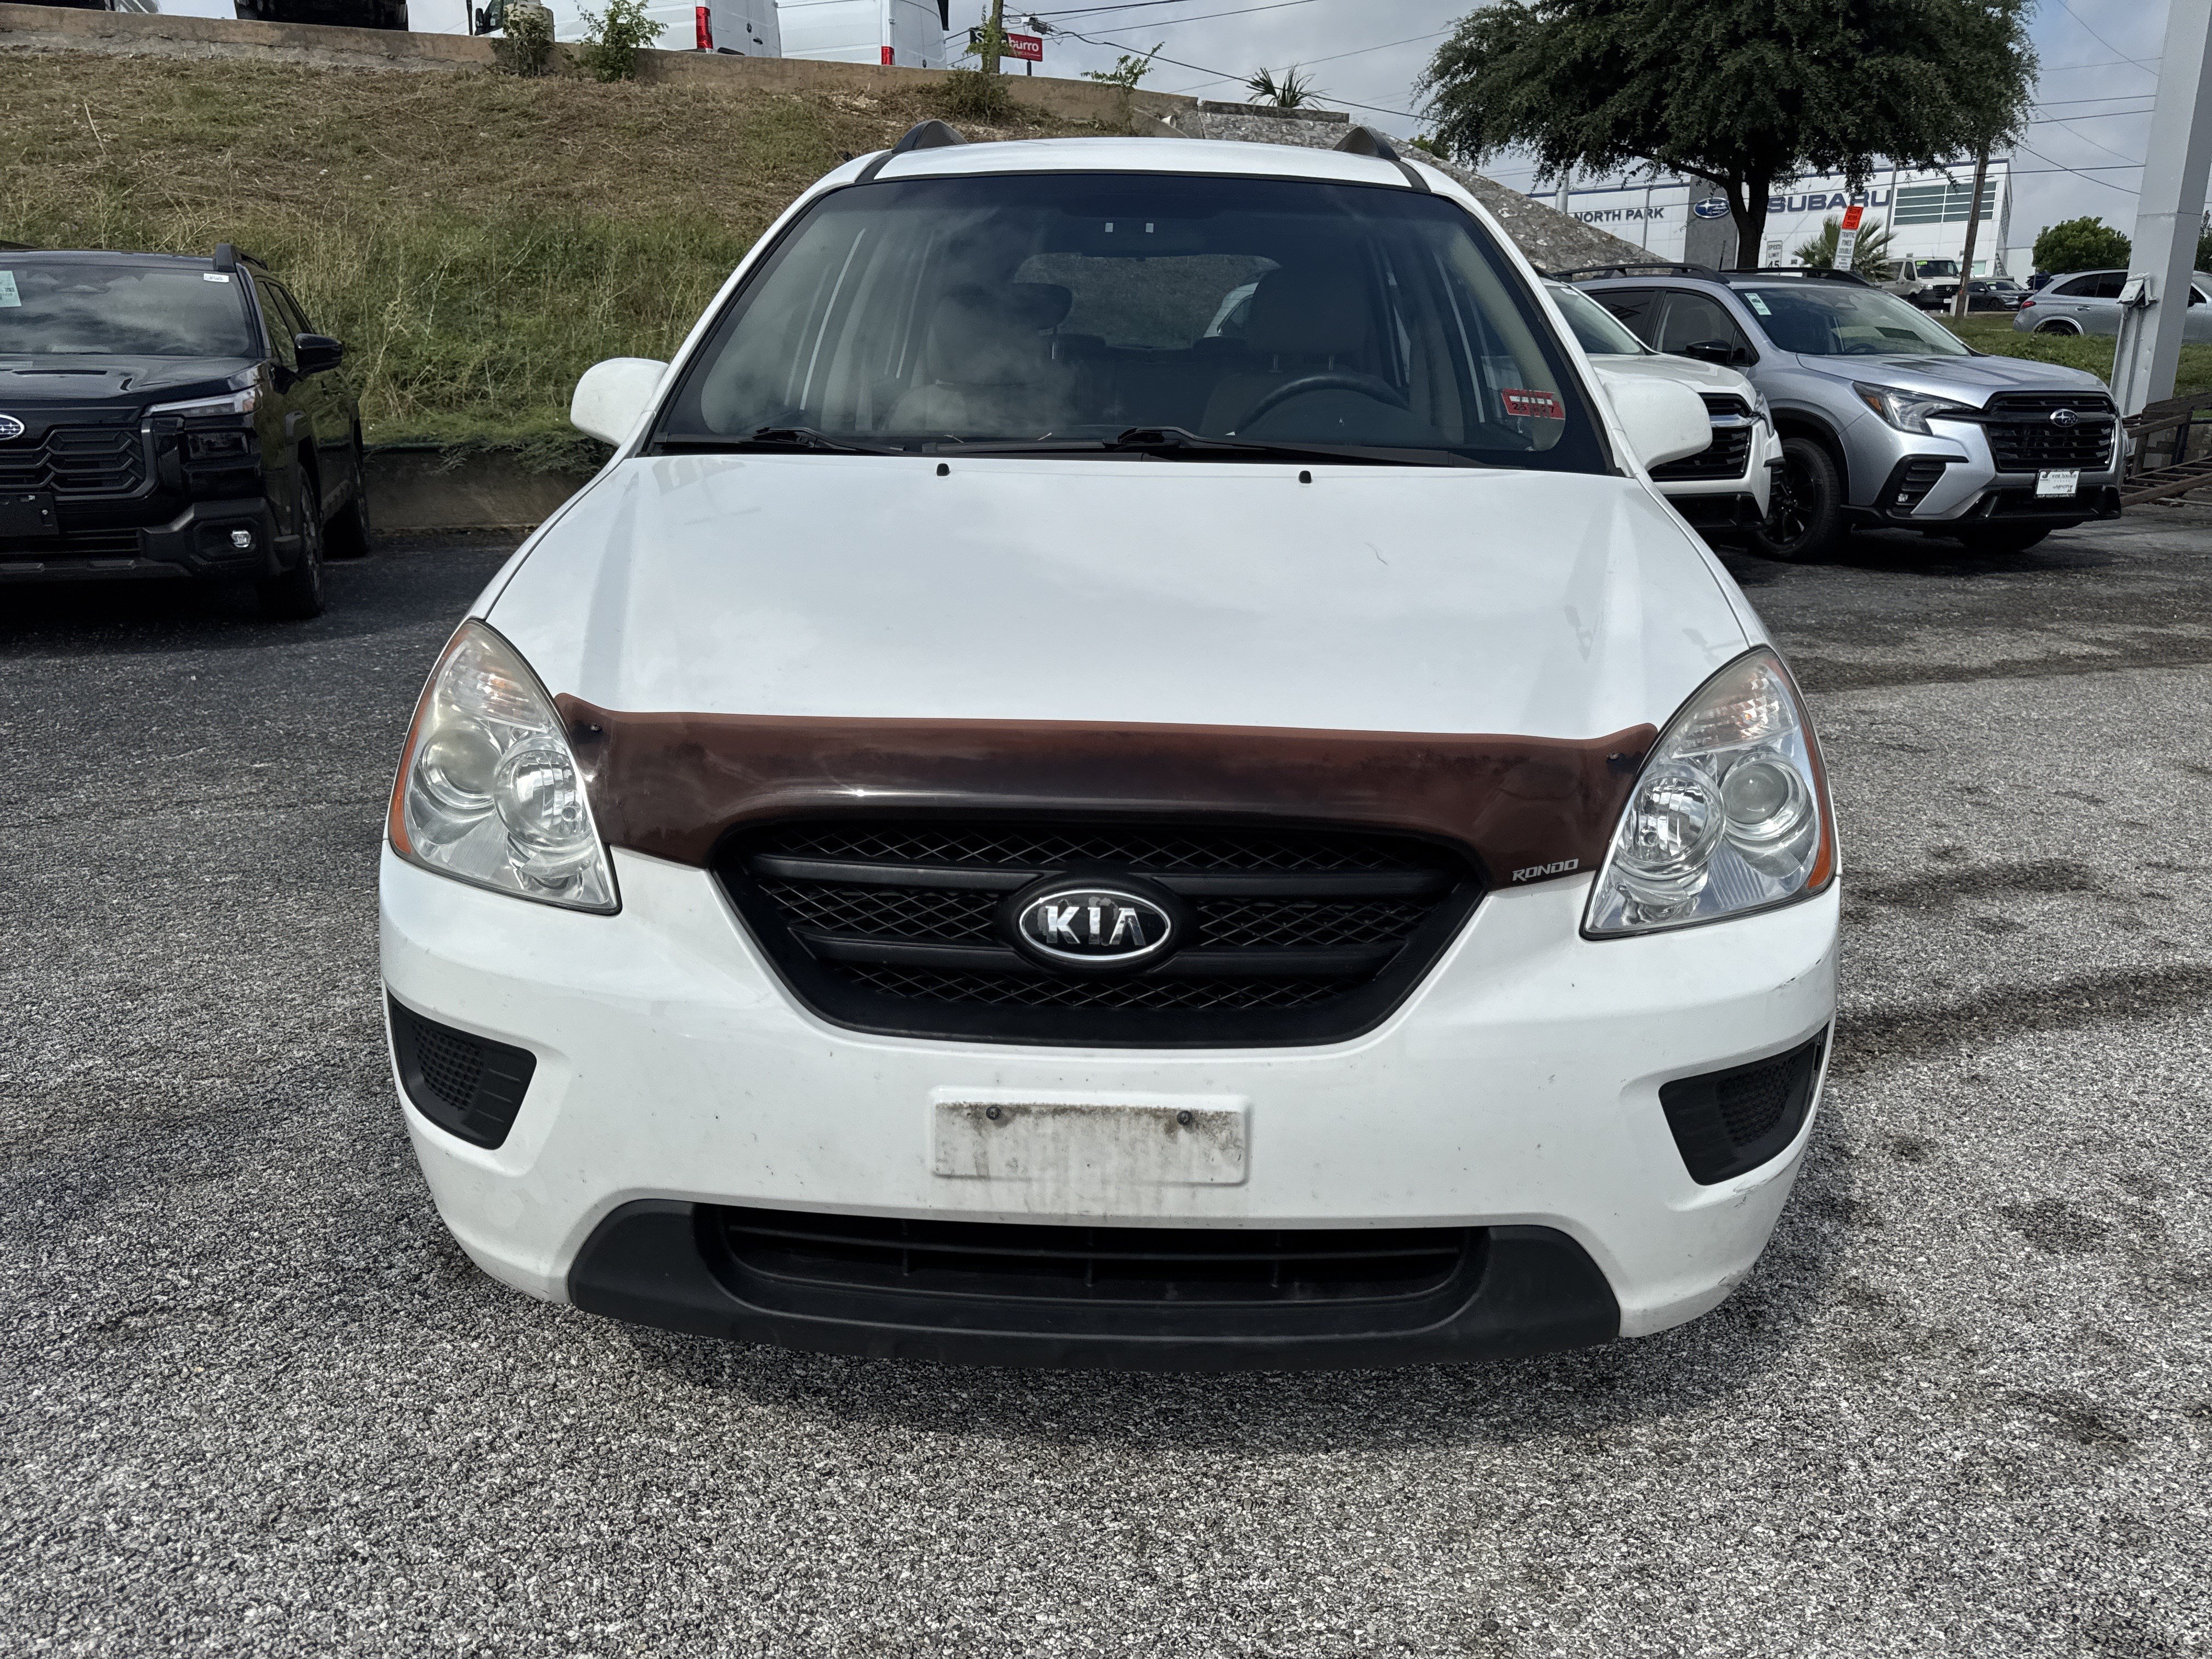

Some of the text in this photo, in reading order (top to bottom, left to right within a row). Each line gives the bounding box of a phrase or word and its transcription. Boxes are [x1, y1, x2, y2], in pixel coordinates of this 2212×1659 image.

[1767, 190, 1891, 213] SUBARU
[1574, 207, 1664, 223] NORTH PARK
[1512, 859, 1579, 881] RONDO
[1046, 906, 1146, 946] KIA
